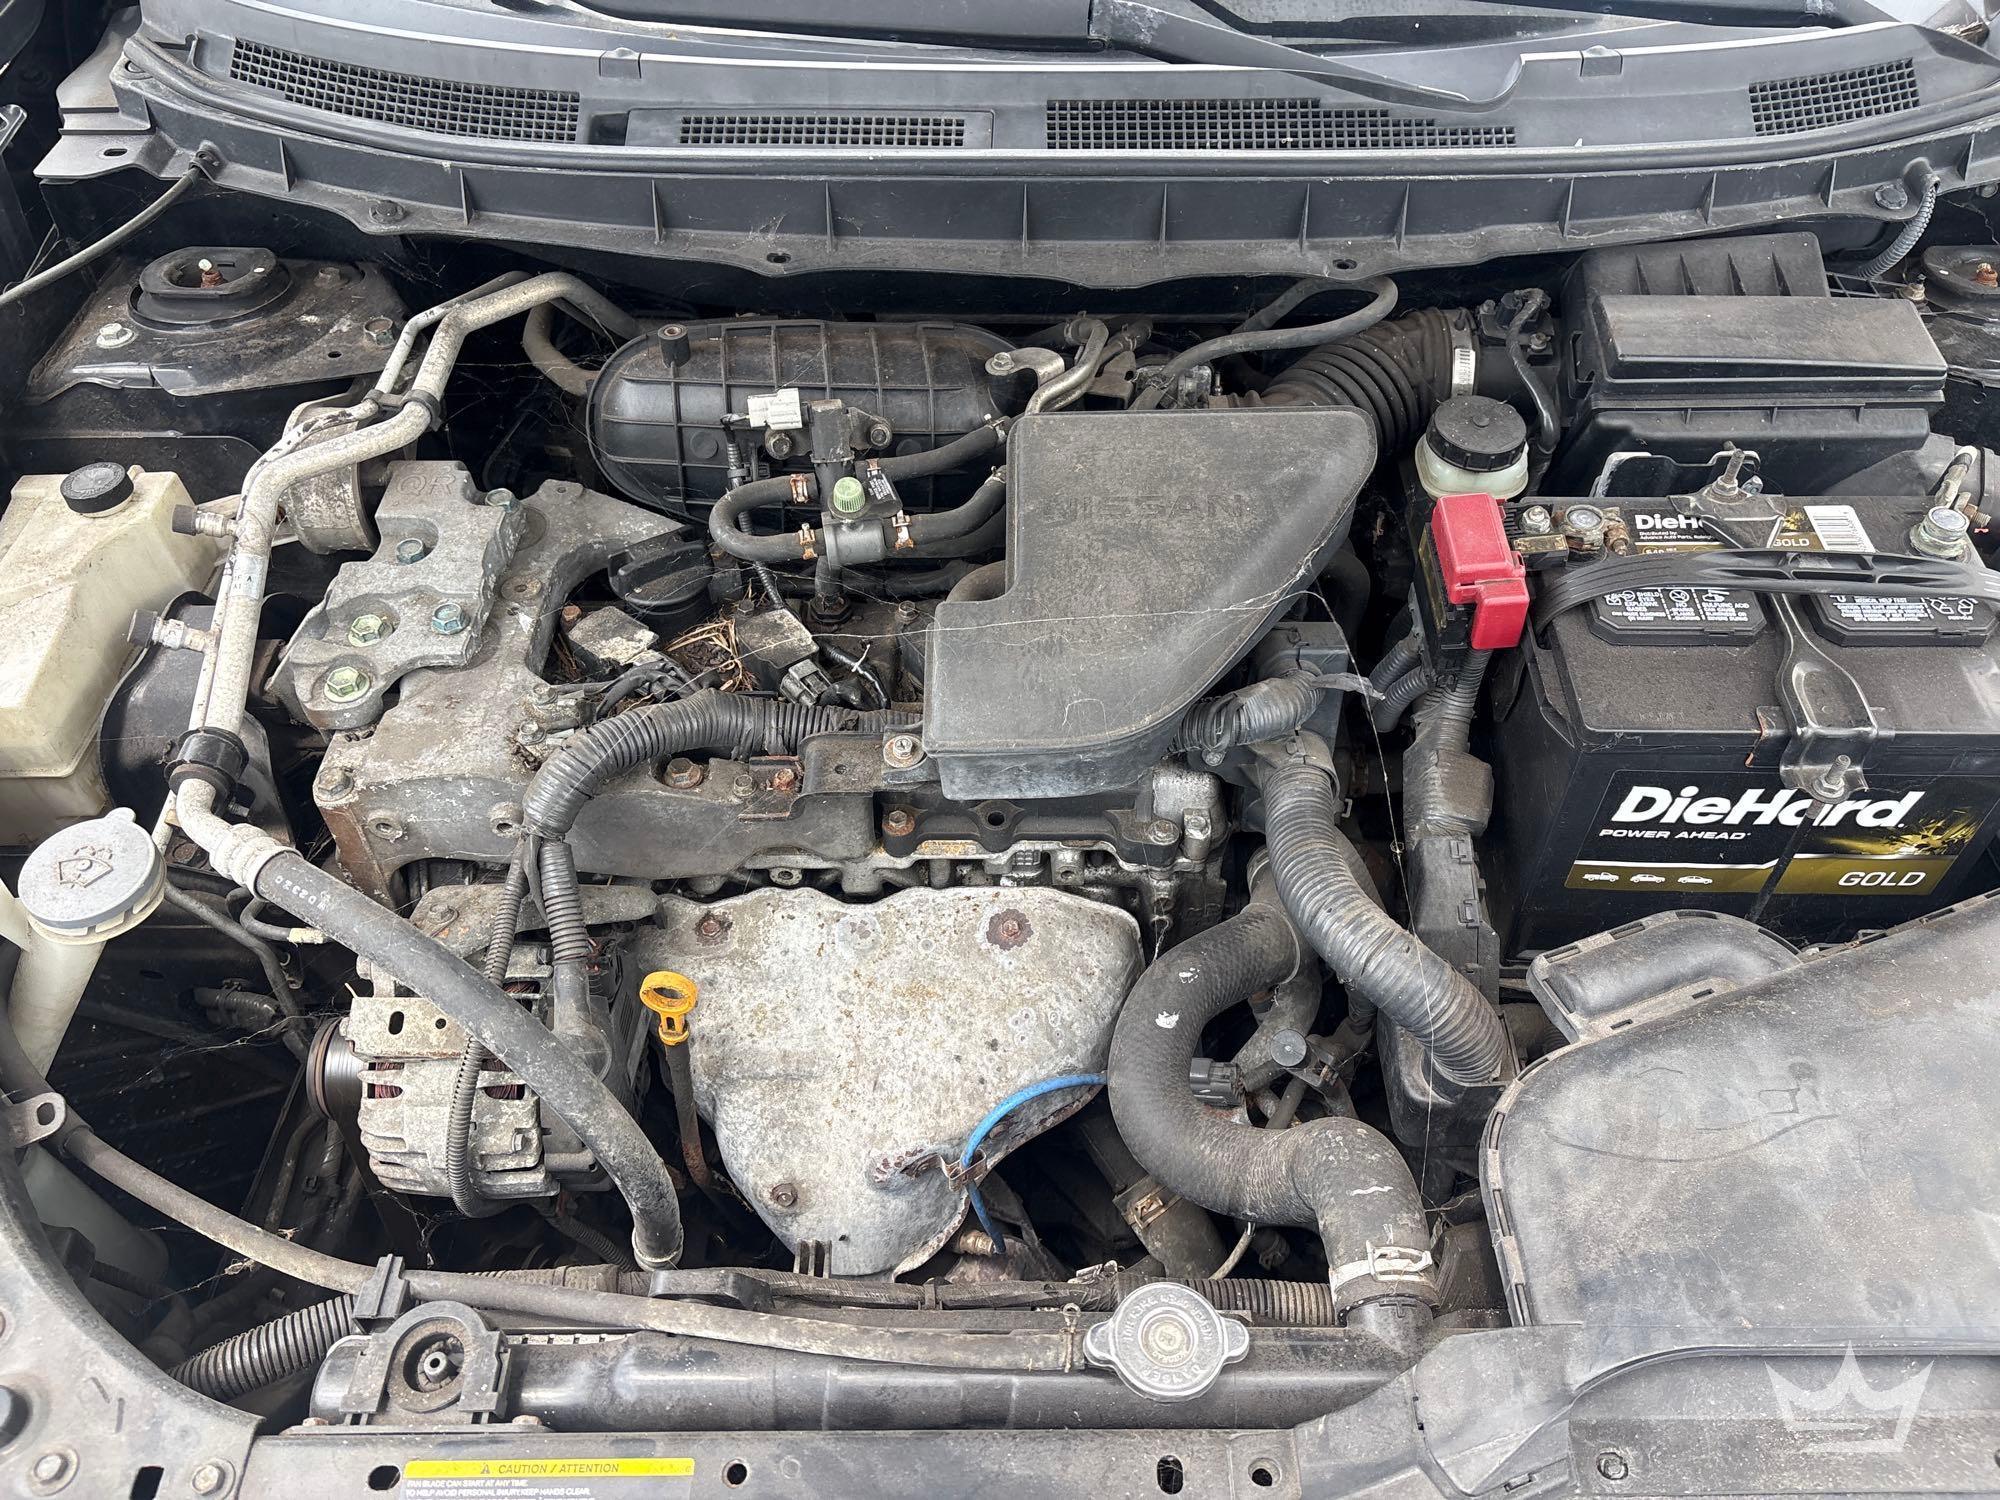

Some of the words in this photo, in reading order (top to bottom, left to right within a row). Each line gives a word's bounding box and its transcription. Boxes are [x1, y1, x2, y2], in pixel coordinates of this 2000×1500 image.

[1599, 829, 1671, 839] POWER
[1837, 871, 1926, 887] GOLD
[497, 1464, 547, 1474] CAUTION
[559, 1463, 620, 1474] ATTENTION
[405, 1489, 416, 1497] TO
[417, 1489, 435, 1497] HELP
[458, 1488, 495, 1496] PERSONAL
[540, 1488, 564, 1496] HANDS
